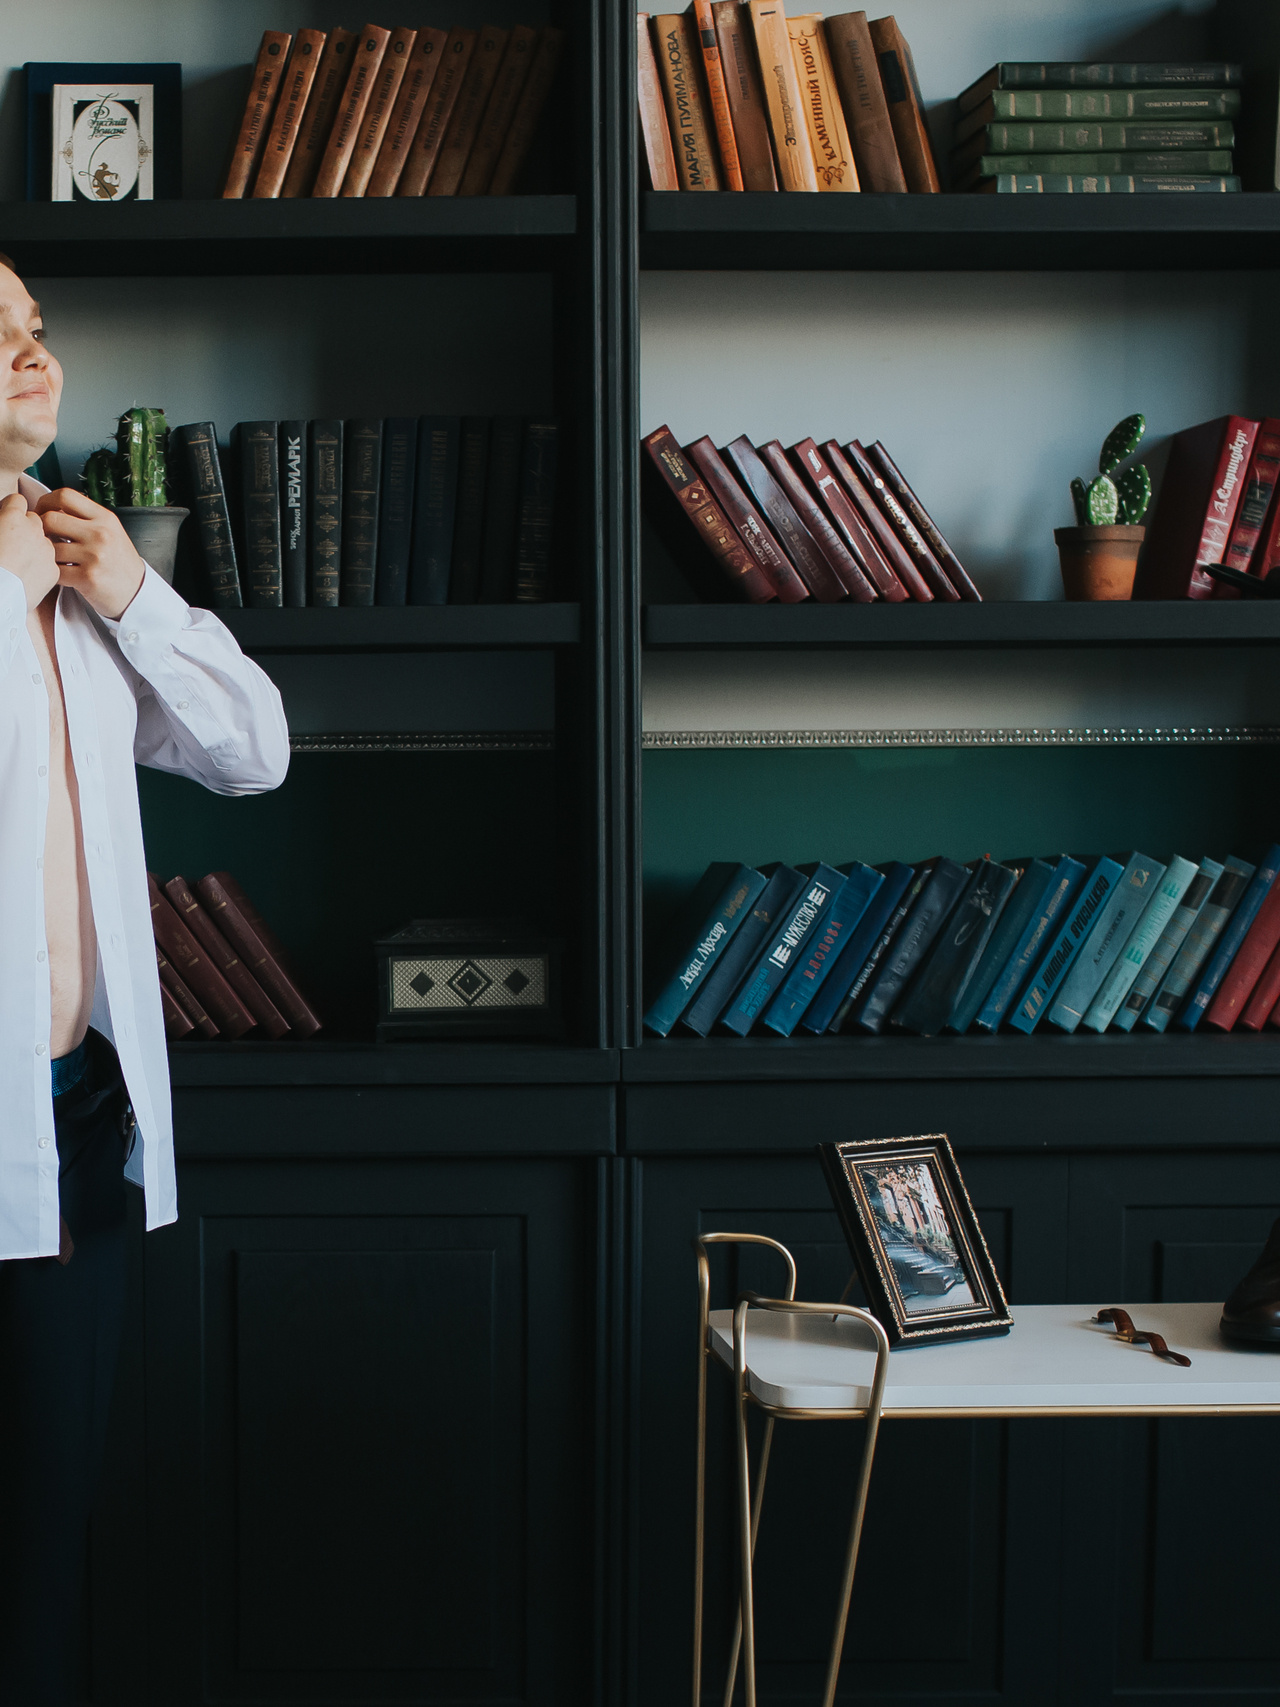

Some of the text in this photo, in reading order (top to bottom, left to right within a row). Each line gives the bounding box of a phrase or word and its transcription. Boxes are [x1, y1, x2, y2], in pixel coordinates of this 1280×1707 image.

[665, 29, 692, 128] ПУЙМАНОВА
[797, 37, 836, 161] КАМЕННЫЙ ПОЯС
[682, 132, 701, 185] МАРИЯ
[287, 435, 301, 507] РЕМАРК
[323, 577, 331, 587] 8
[780, 900, 819, 947] МУЖЕСТВО
